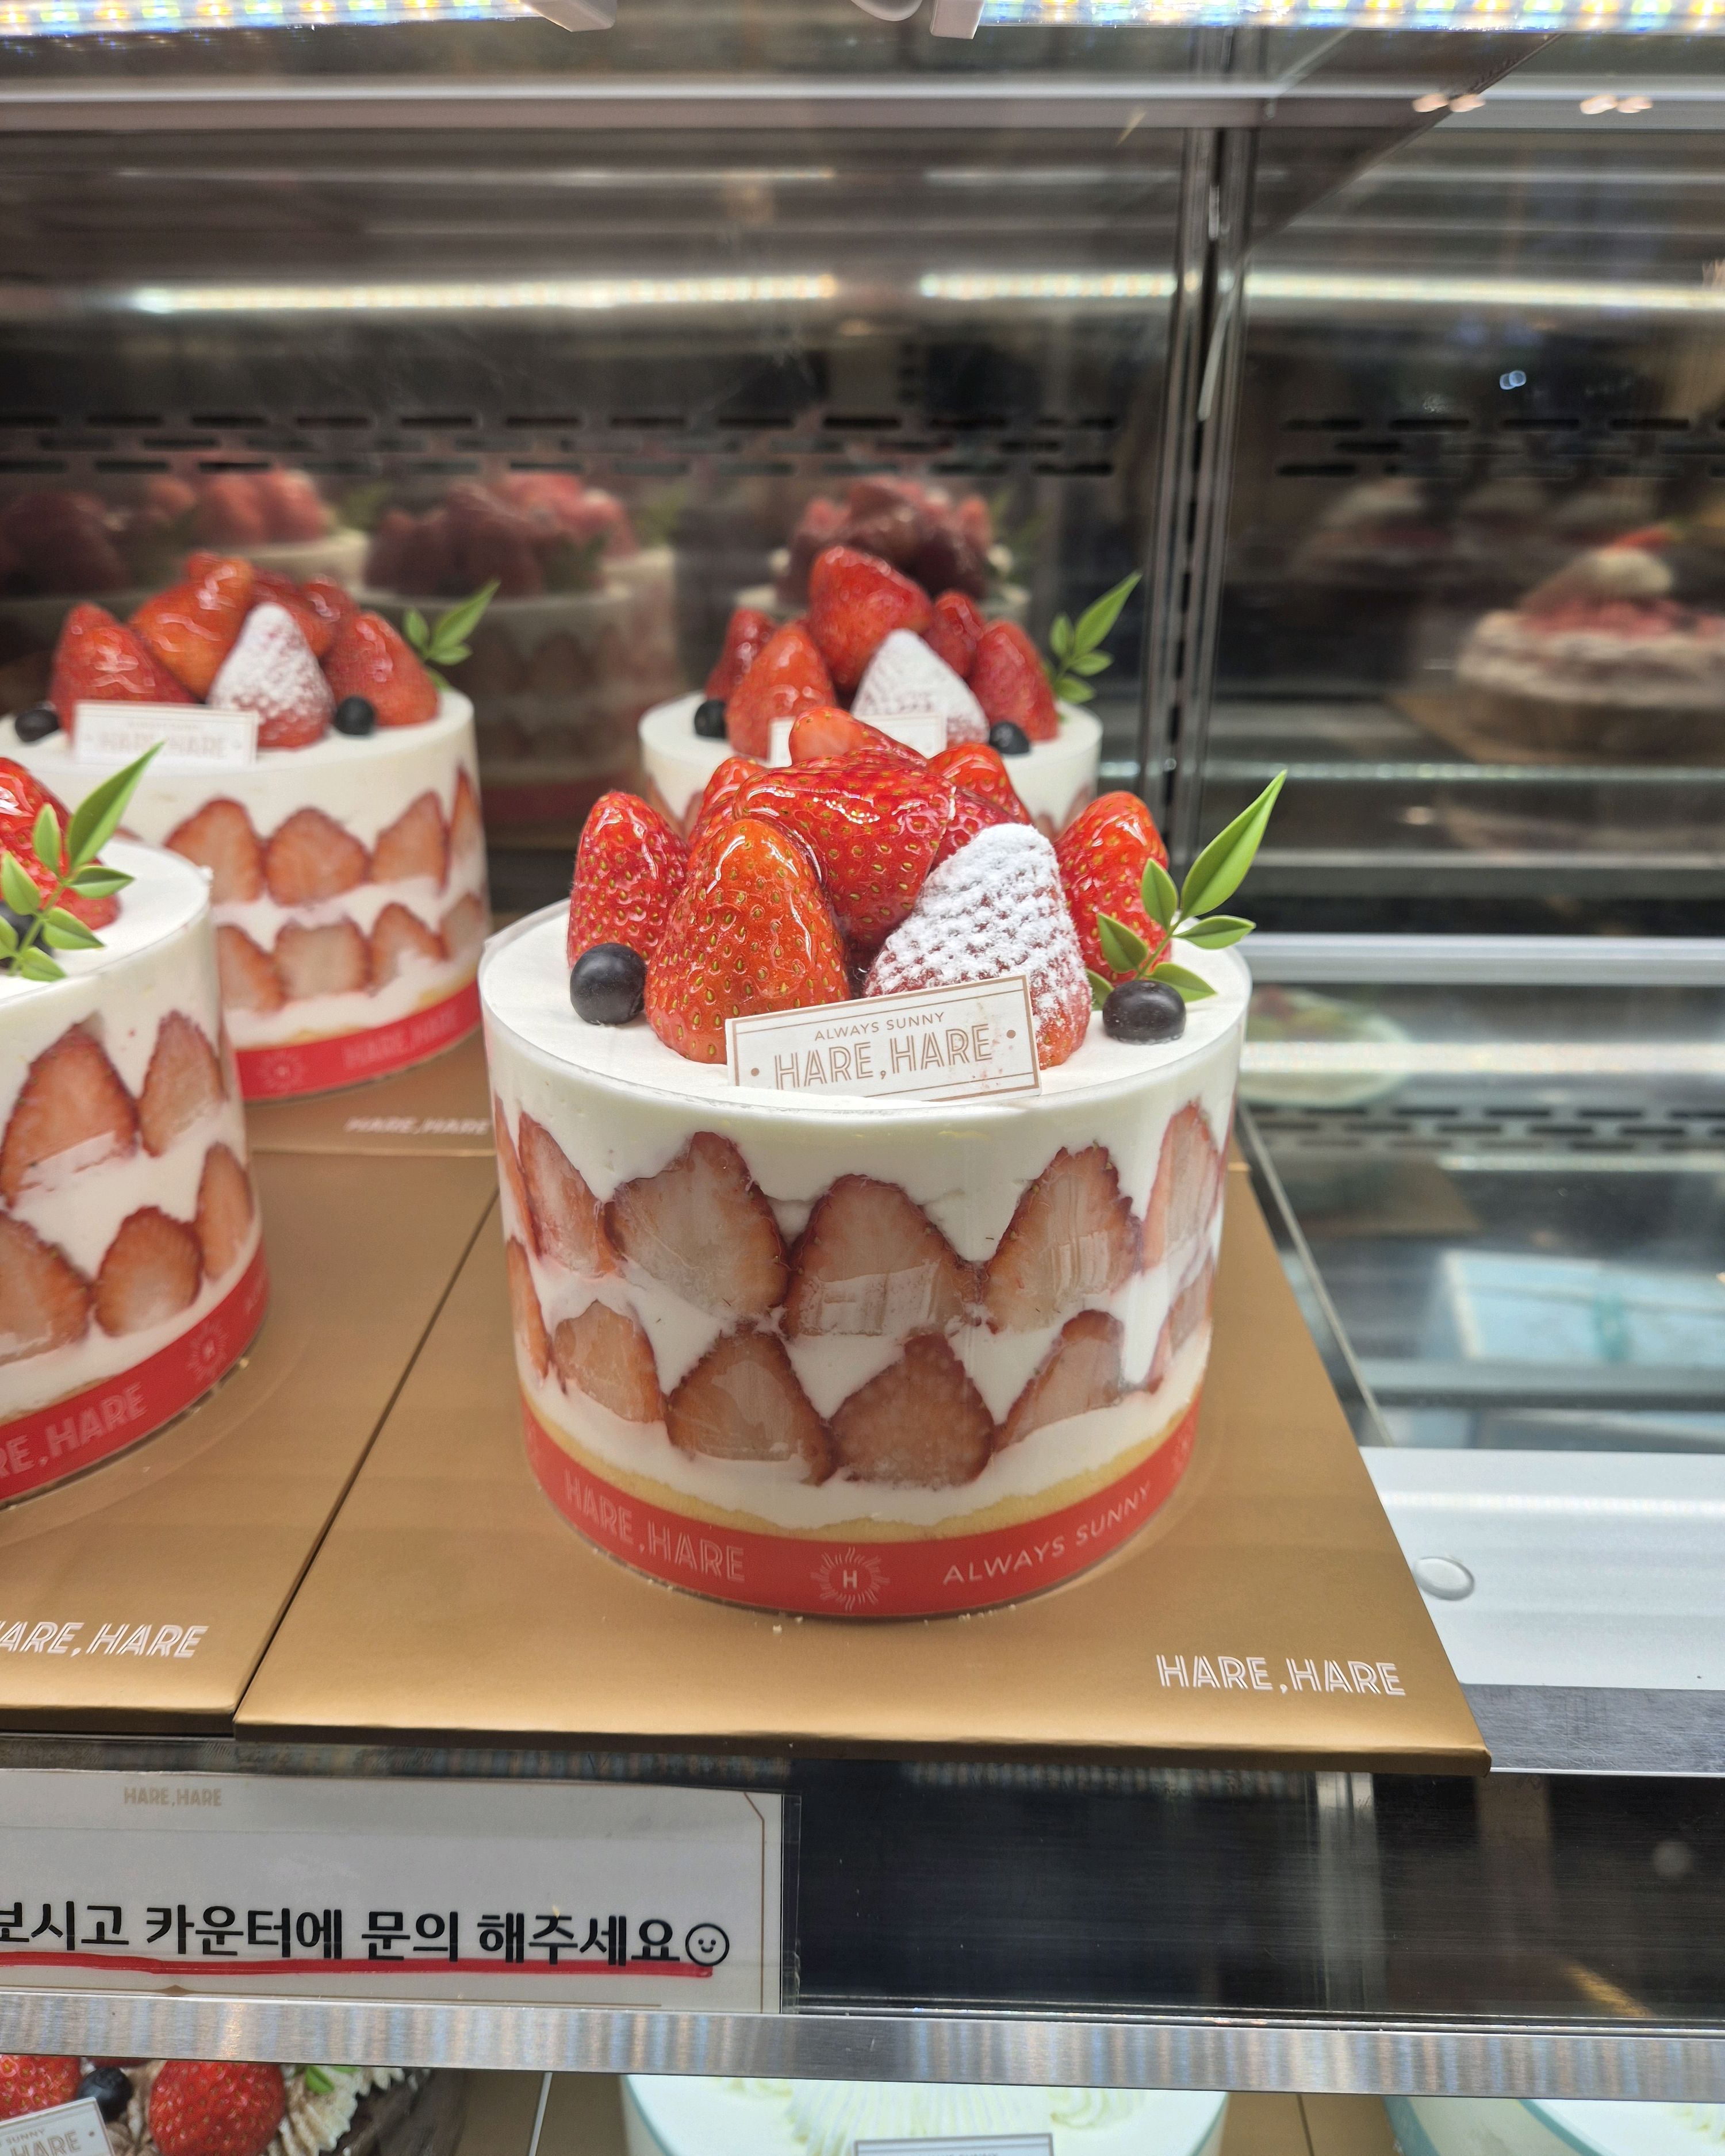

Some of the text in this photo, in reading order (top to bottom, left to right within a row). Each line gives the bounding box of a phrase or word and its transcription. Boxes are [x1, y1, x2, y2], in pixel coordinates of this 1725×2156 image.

[814, 1011, 945, 1041] ALWAYS SUNNY
[774, 1023, 994, 1091] HARE,HARE
[942, 1480, 1151, 1586] ALWAYS SUNNY
[842, 1569, 858, 1589] H
[0, 1620, 210, 1659] ARE,HARE
[1156, 1654, 1406, 1697] HARE,HARE
[0, 1901, 681, 1967] 보시고 카운터에 문의 해주세요
[5, 2127, 45, 2146] SUNNY
